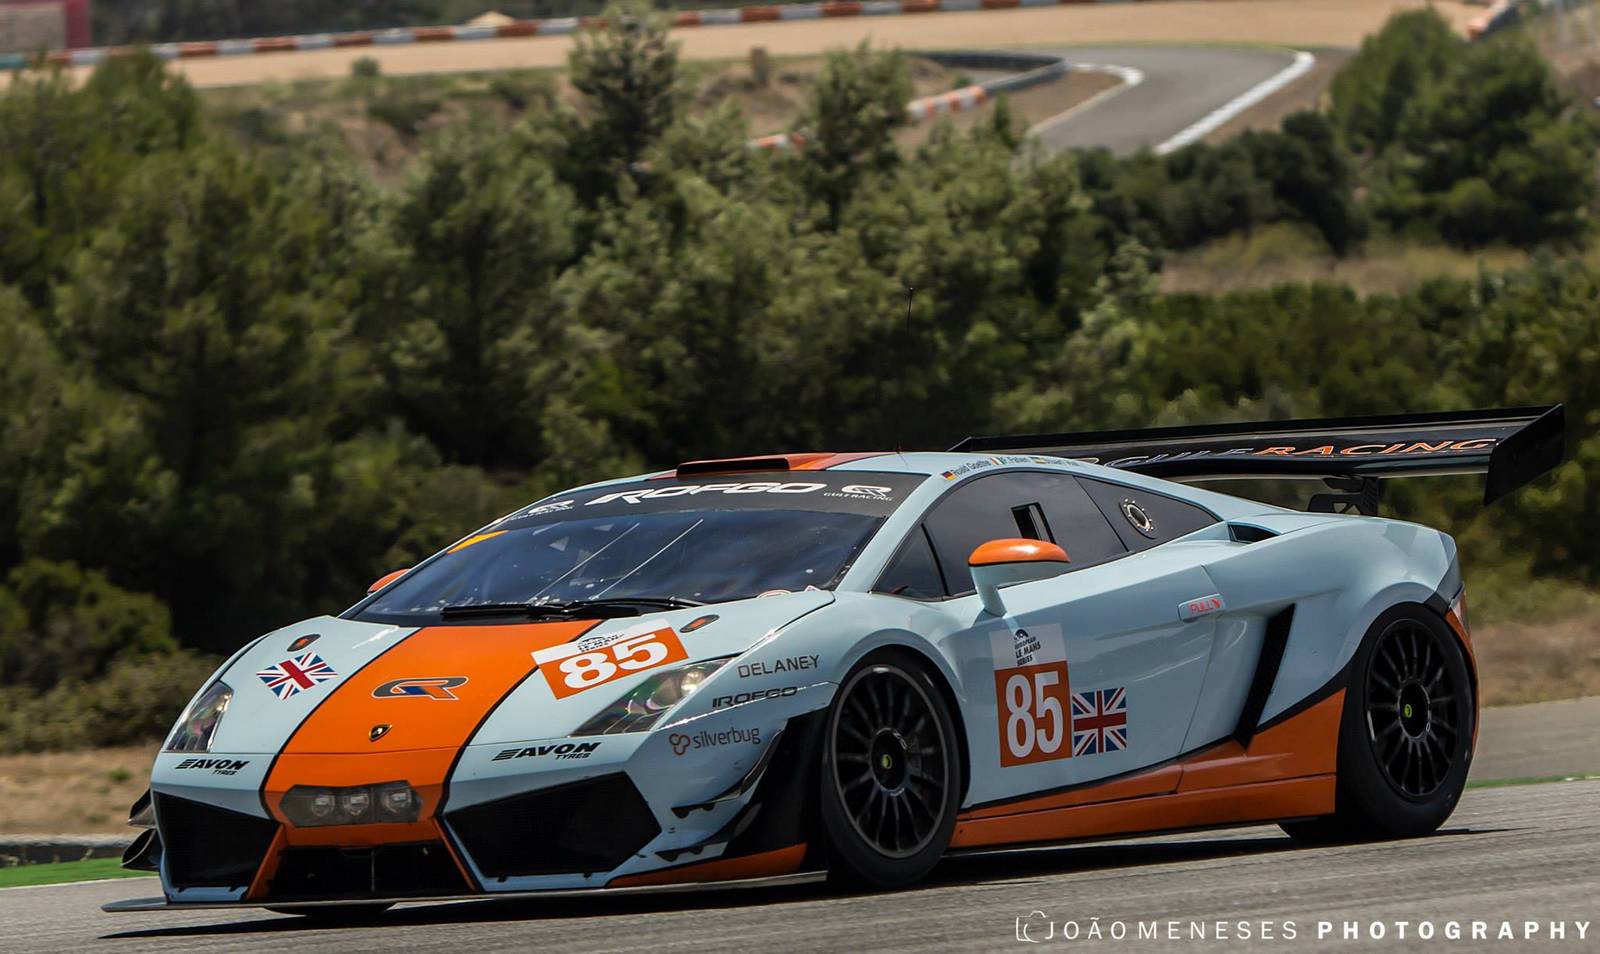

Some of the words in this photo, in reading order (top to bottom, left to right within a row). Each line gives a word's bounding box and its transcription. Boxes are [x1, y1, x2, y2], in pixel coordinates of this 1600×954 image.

[584, 480, 828, 506] ROFGO
[559, 633, 669, 690] 85
[738, 654, 820, 678] DELANEY
[1005, 670, 1065, 759] 85
[693, 726, 761, 749] silverbug
[514, 741, 602, 759] AVON
[555, 752, 592, 760] TYRES
[188, 758, 250, 770] AVON
